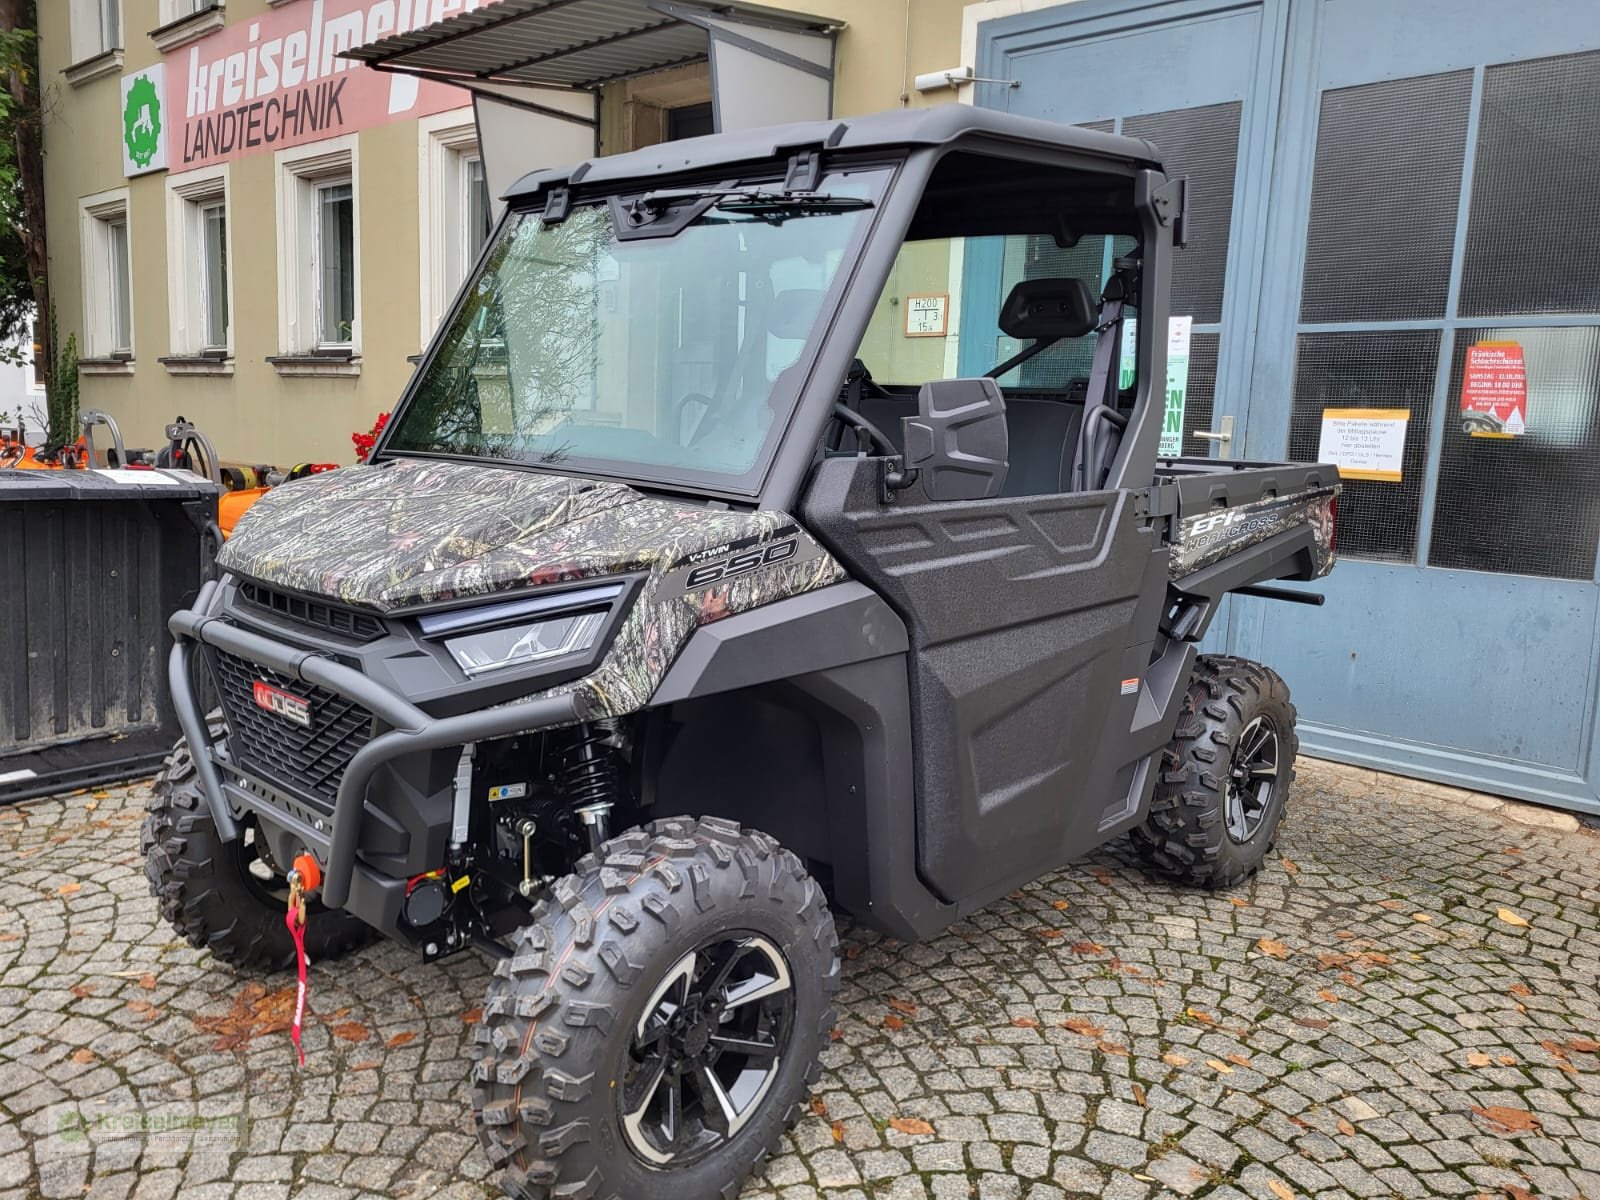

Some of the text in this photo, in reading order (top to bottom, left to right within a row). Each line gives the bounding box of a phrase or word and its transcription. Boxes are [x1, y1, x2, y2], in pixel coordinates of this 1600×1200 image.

[186, 0, 481, 118] kreiselmey
[183, 76, 348, 164] LANDTECHNIK
[1347, 428, 1387, 436] Mittagspause
[1190, 511, 1235, 537] EFI
[685, 537, 799, 590] 650
[689, 544, 730, 562] V-TWIN
